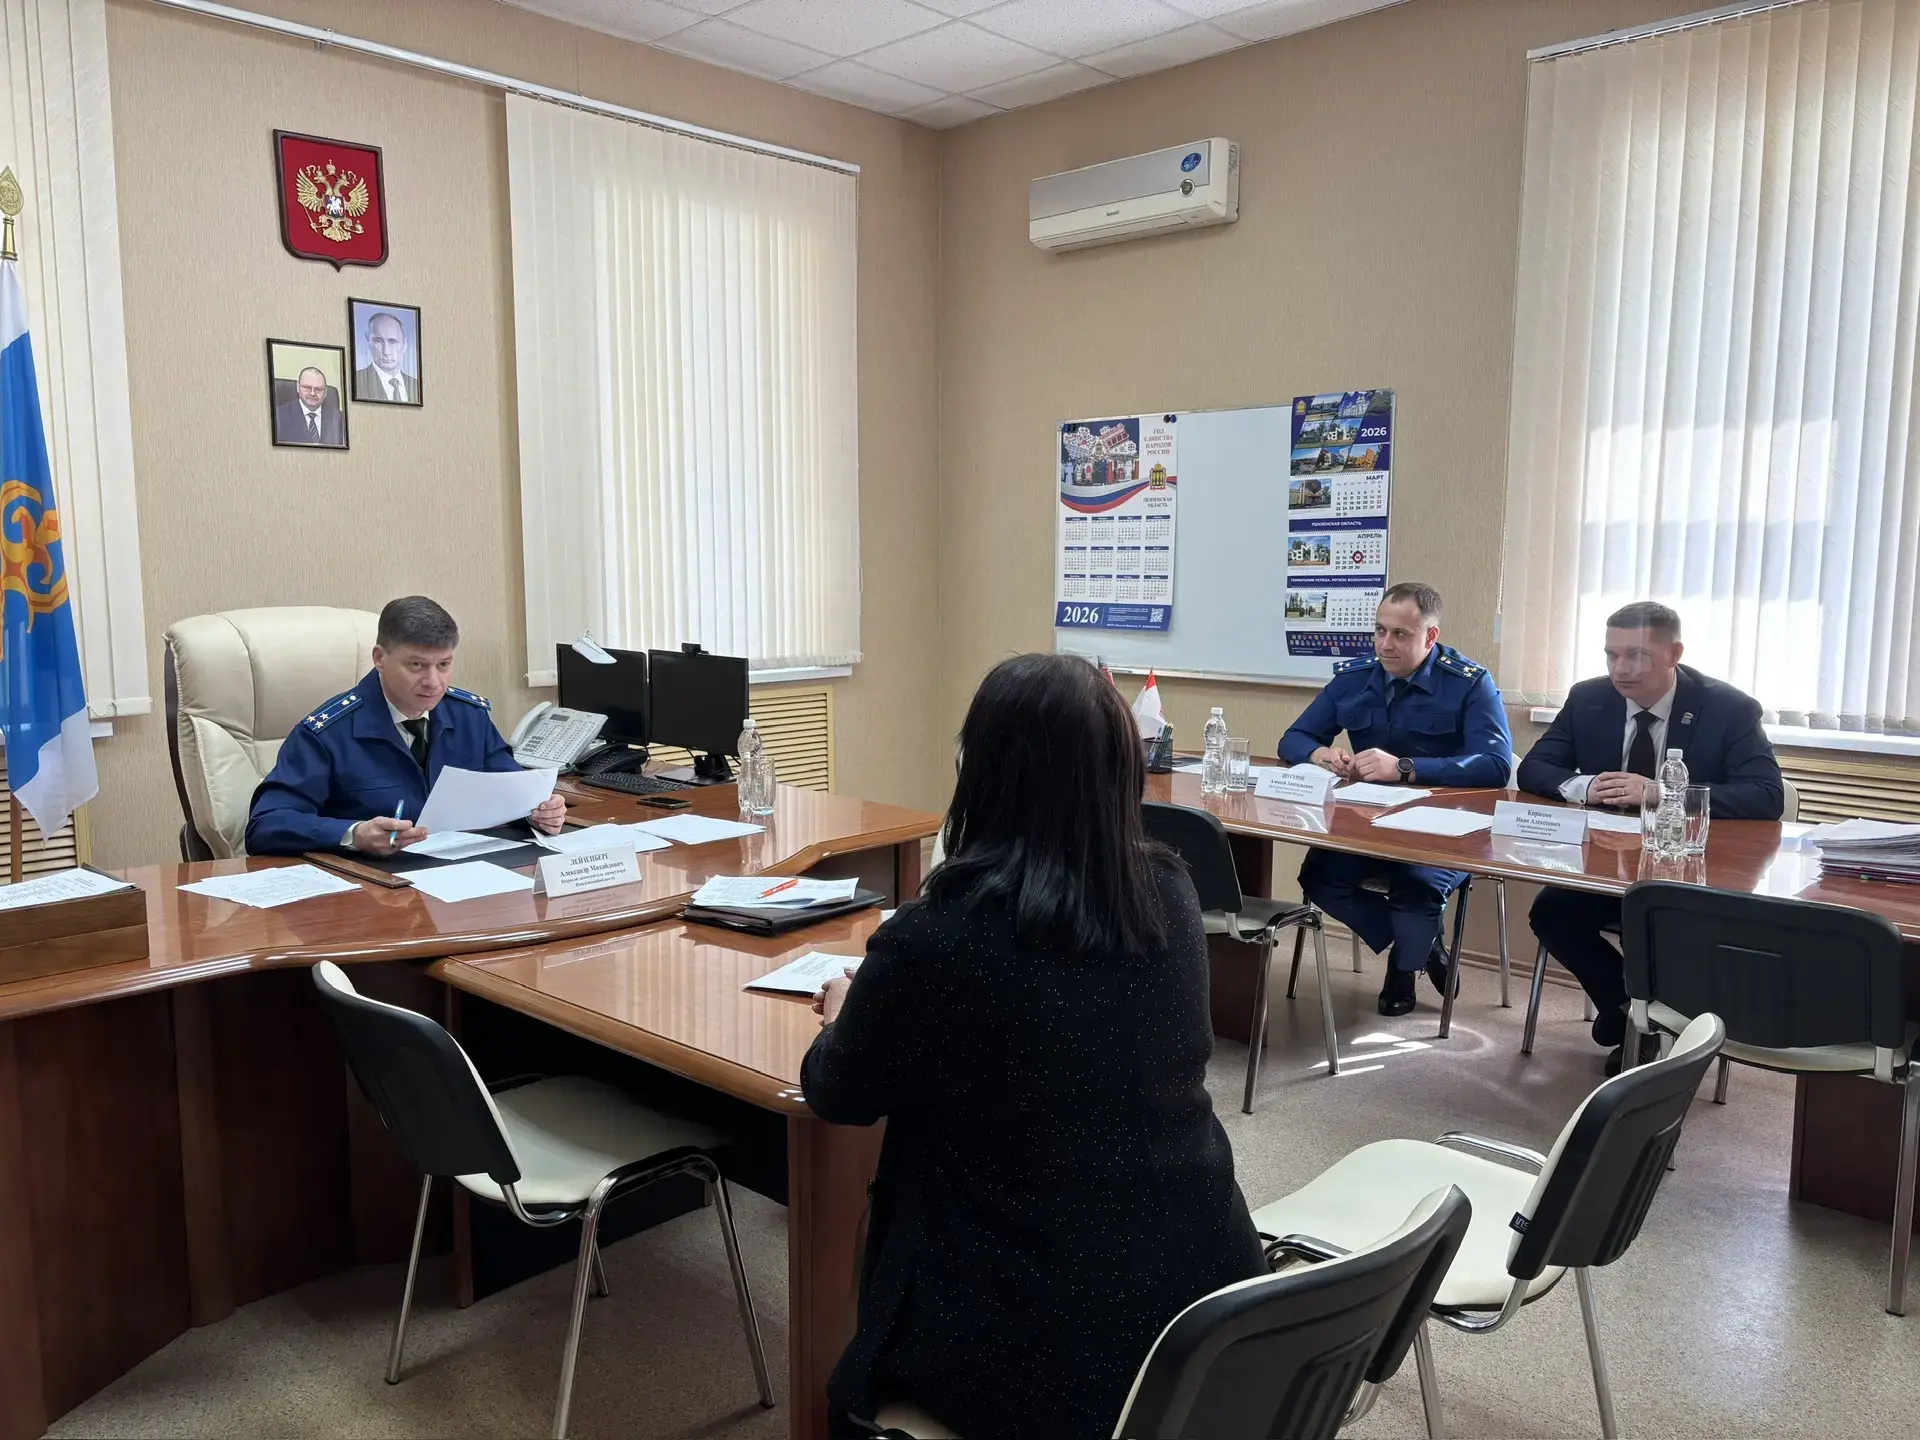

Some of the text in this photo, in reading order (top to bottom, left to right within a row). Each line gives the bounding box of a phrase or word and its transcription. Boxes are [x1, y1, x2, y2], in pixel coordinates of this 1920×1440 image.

[1360, 427, 1387, 438] 2026
[1062, 606, 1100, 624] 2026
[1516, 816, 1561, 827] Иван Алексеевич
[570, 852, 609, 866] ЛЕЙЗЕНБЕРГ
[560, 861, 624, 878] Александр Михайлович
